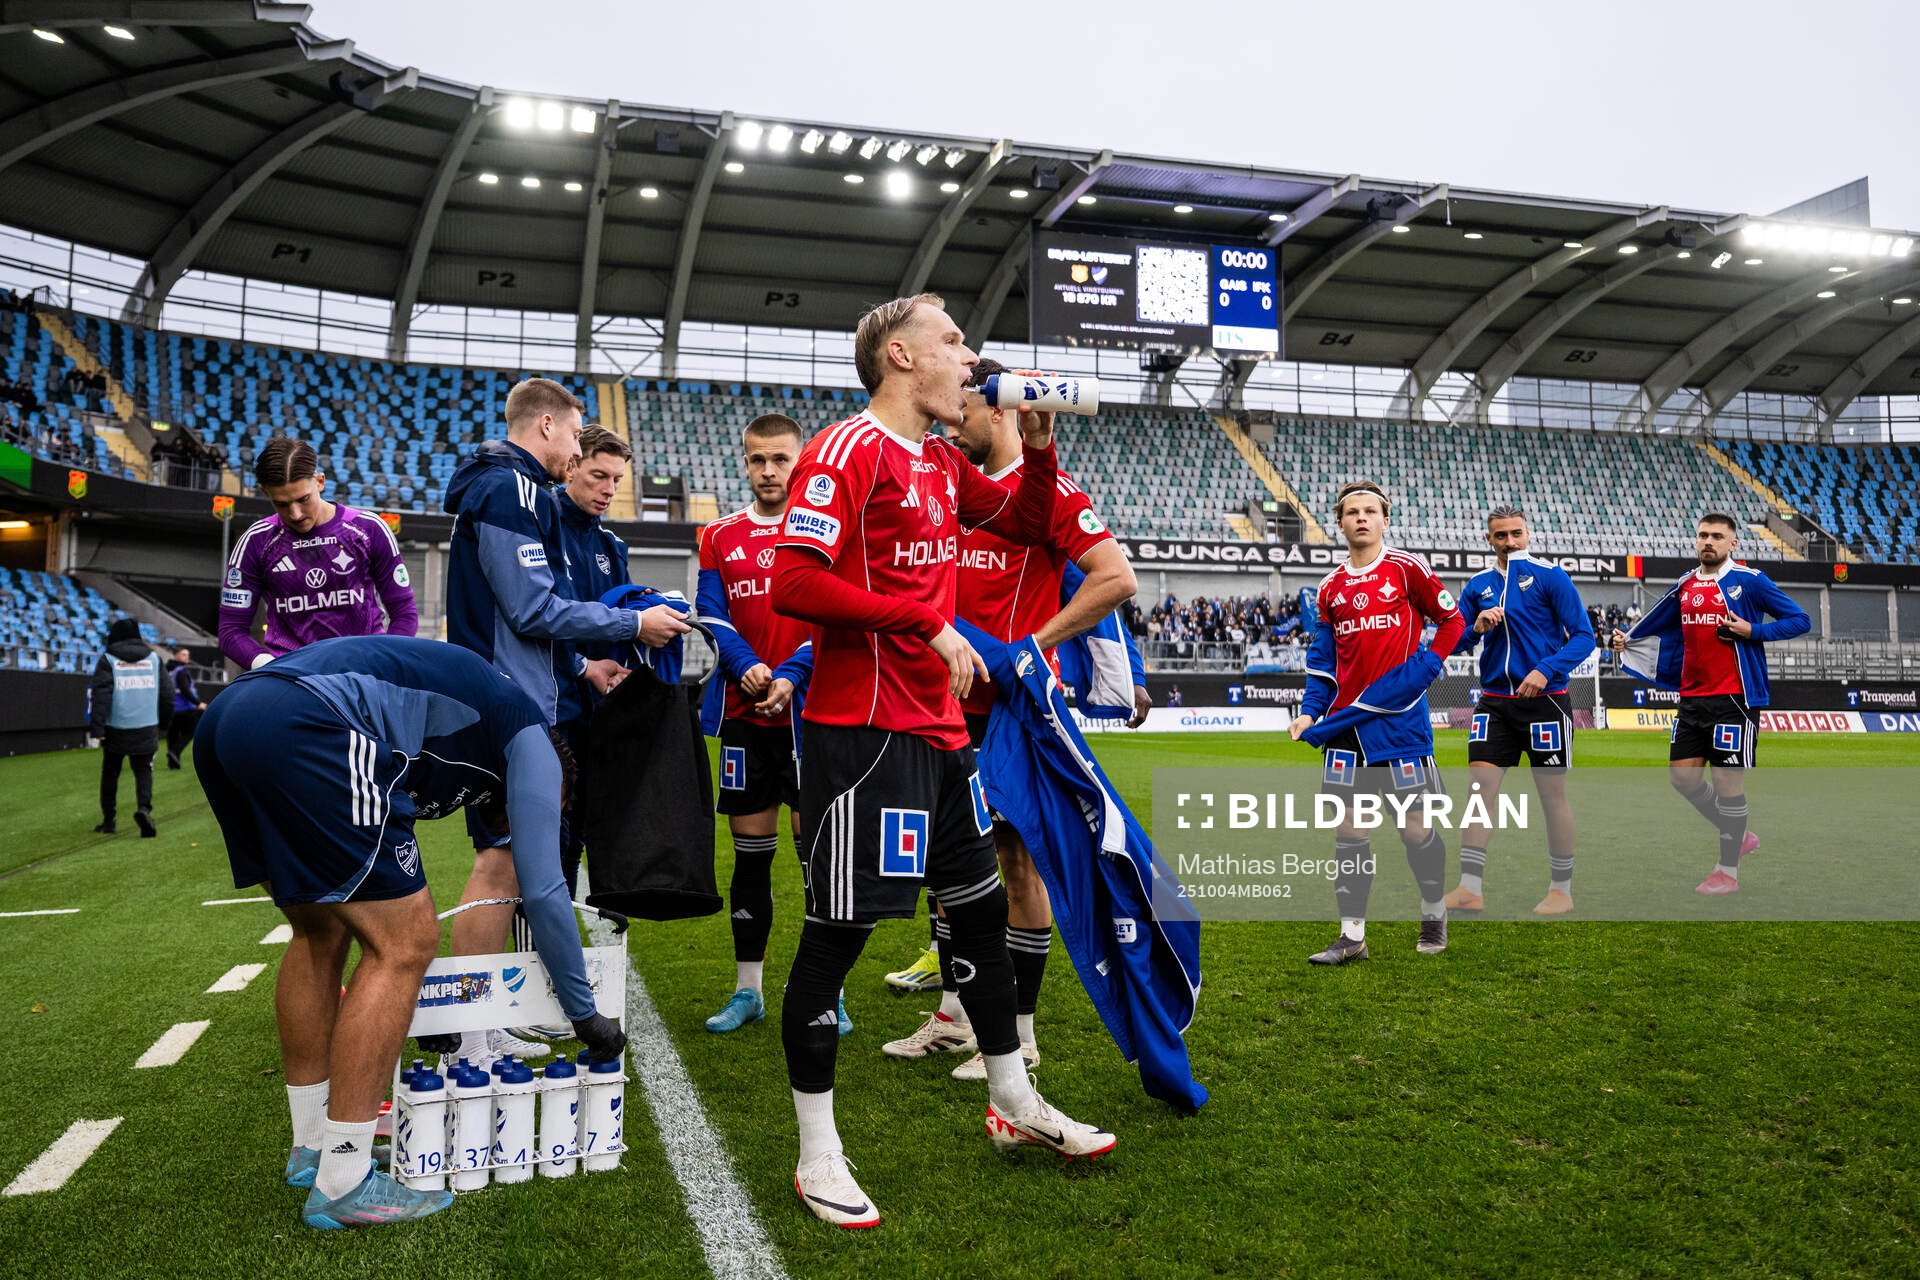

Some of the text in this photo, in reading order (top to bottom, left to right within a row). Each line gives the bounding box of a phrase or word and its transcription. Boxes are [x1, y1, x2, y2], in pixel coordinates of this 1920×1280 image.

[271, 243, 311, 263] P1
[1221, 250, 1267, 270] 00:00
[477, 270, 516, 288] P2
[1219, 278, 1271, 293] GAIS IFK
[765, 291, 800, 308] P3
[1219, 292, 1272, 310] 0 0
[1319, 332, 1355, 347] B4
[1564, 350, 1598, 364] B3
[789, 513, 837, 534] UNIBET
[292, 536, 338, 549] stadium
[1138, 543, 1263, 562] SJUNGA
[1267, 543, 1305, 563] SÅ
[1345, 574, 1378, 587] stadium
[275, 587, 366, 614] HOLMEN
[1334, 612, 1401, 637] HOLMEN
[1860, 690, 1917, 705] Tranpenad
[1181, 715, 1244, 726] GIGANT
[418, 1151, 442, 1174] 19
[465, 1146, 489, 1168] 37
[552, 1144, 565, 1166] 8
